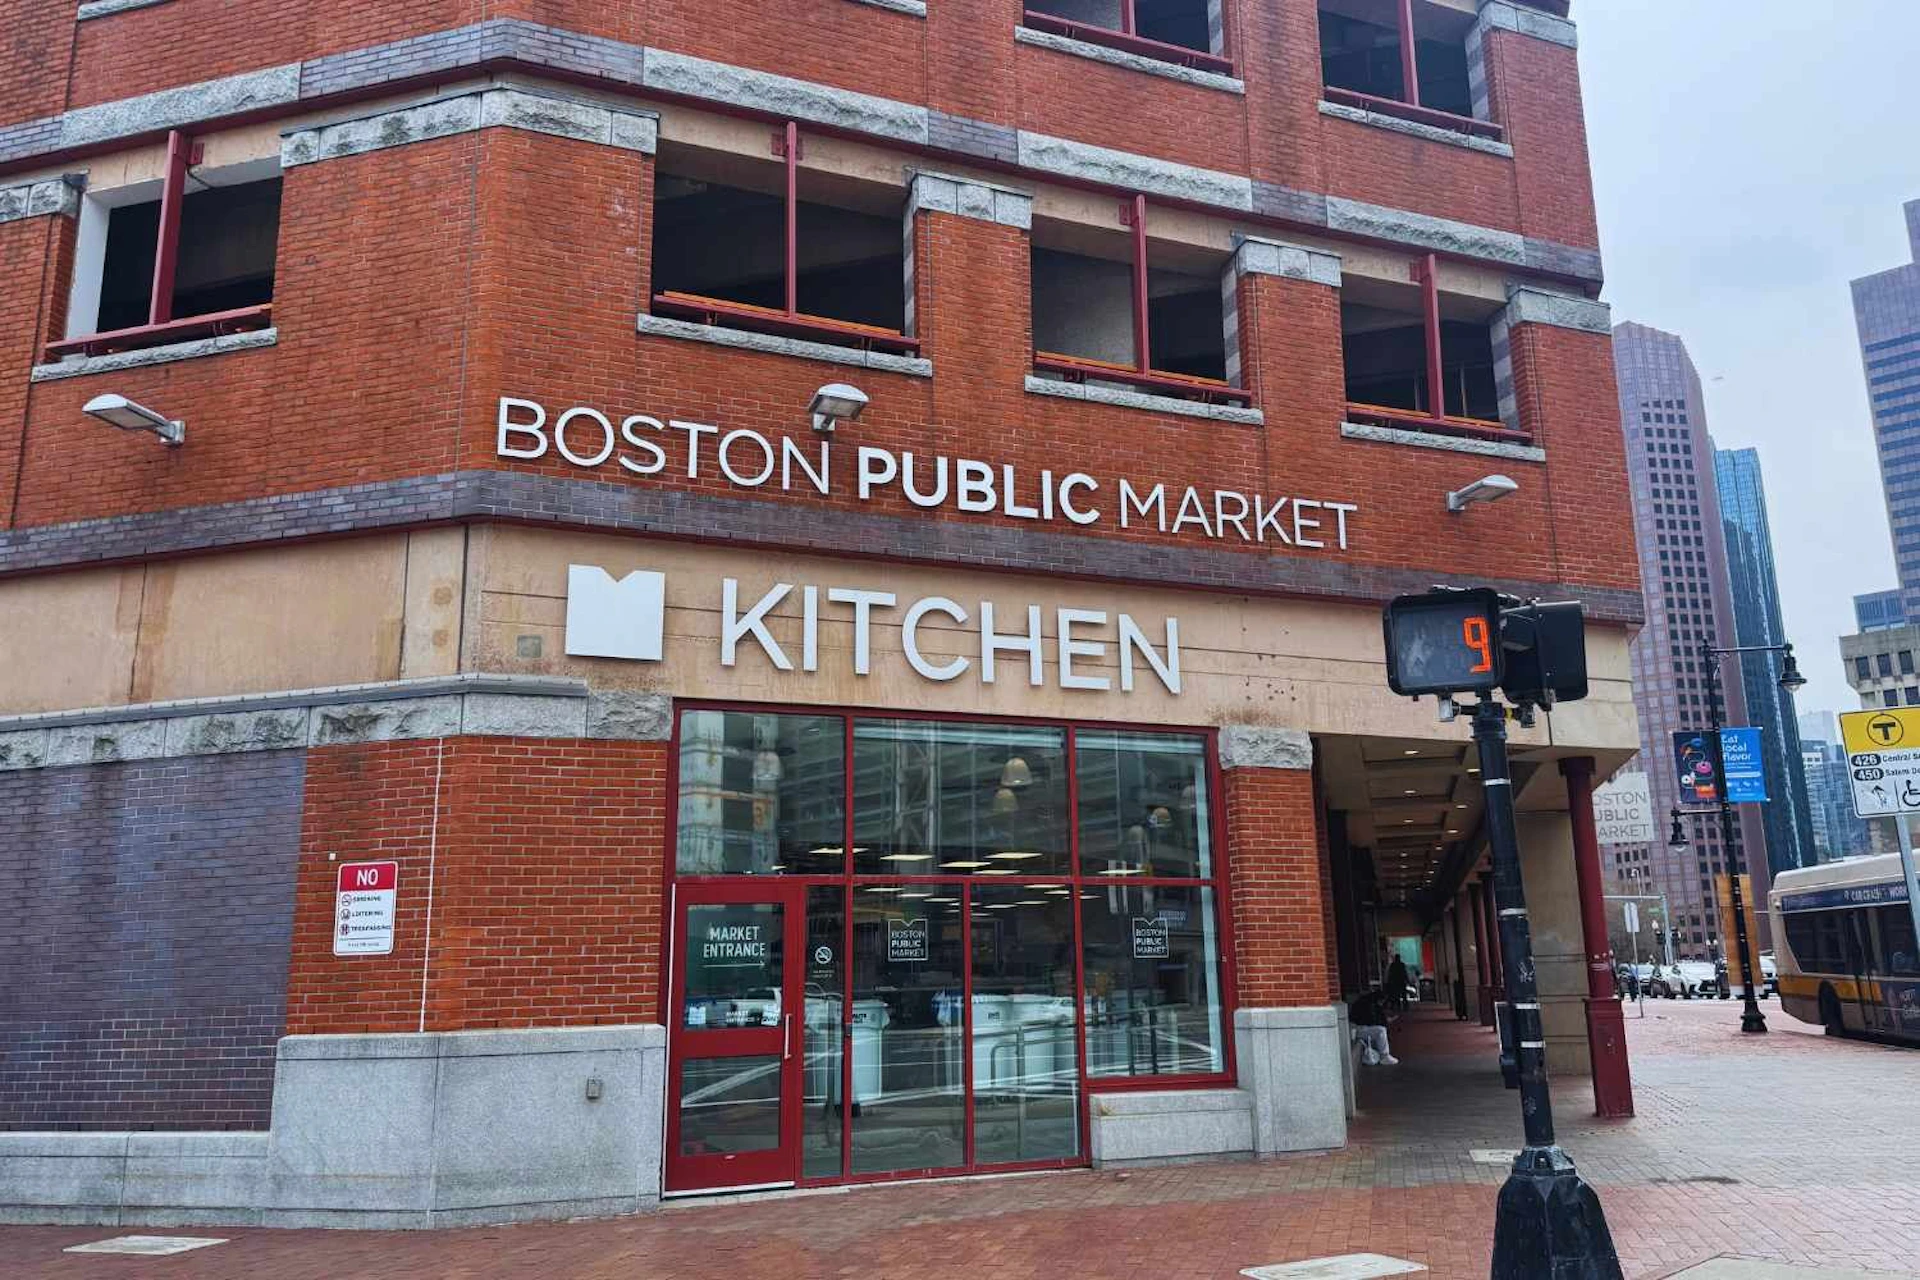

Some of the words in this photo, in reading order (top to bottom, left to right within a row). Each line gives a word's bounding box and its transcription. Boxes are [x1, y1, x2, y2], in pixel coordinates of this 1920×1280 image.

[496, 396, 830, 496] BOSTON
[857, 446, 1100, 526] PUBLIC
[1118, 477, 1359, 551] MARKET
[720, 577, 1183, 696] KITCHEN
[1463, 616, 1492, 674] 9
[1722, 742, 1747, 752] local
[1722, 752, 1752, 761] flavor
[1854, 754, 1878, 766] 426
[1882, 753, 1911, 763] Central
[1857, 768, 1881, 780] 450
[1885, 768, 1910, 777] Salem
[1594, 808, 1640, 822] UBLIC
[1598, 823, 1650, 839] ARKET
[356, 868, 379, 887] NO
[708, 925, 760, 941] MARKET
[891, 929, 925, 939] BOSTON
[1136, 928, 1166, 937] BOSTON
[891, 939, 922, 948] PUBLIC
[1136, 937, 1162, 946] PUBLIC
[703, 942, 766, 959] ENTRANCE
[891, 948, 925, 957] MARKET
[1136, 945, 1167, 954] MARKET
